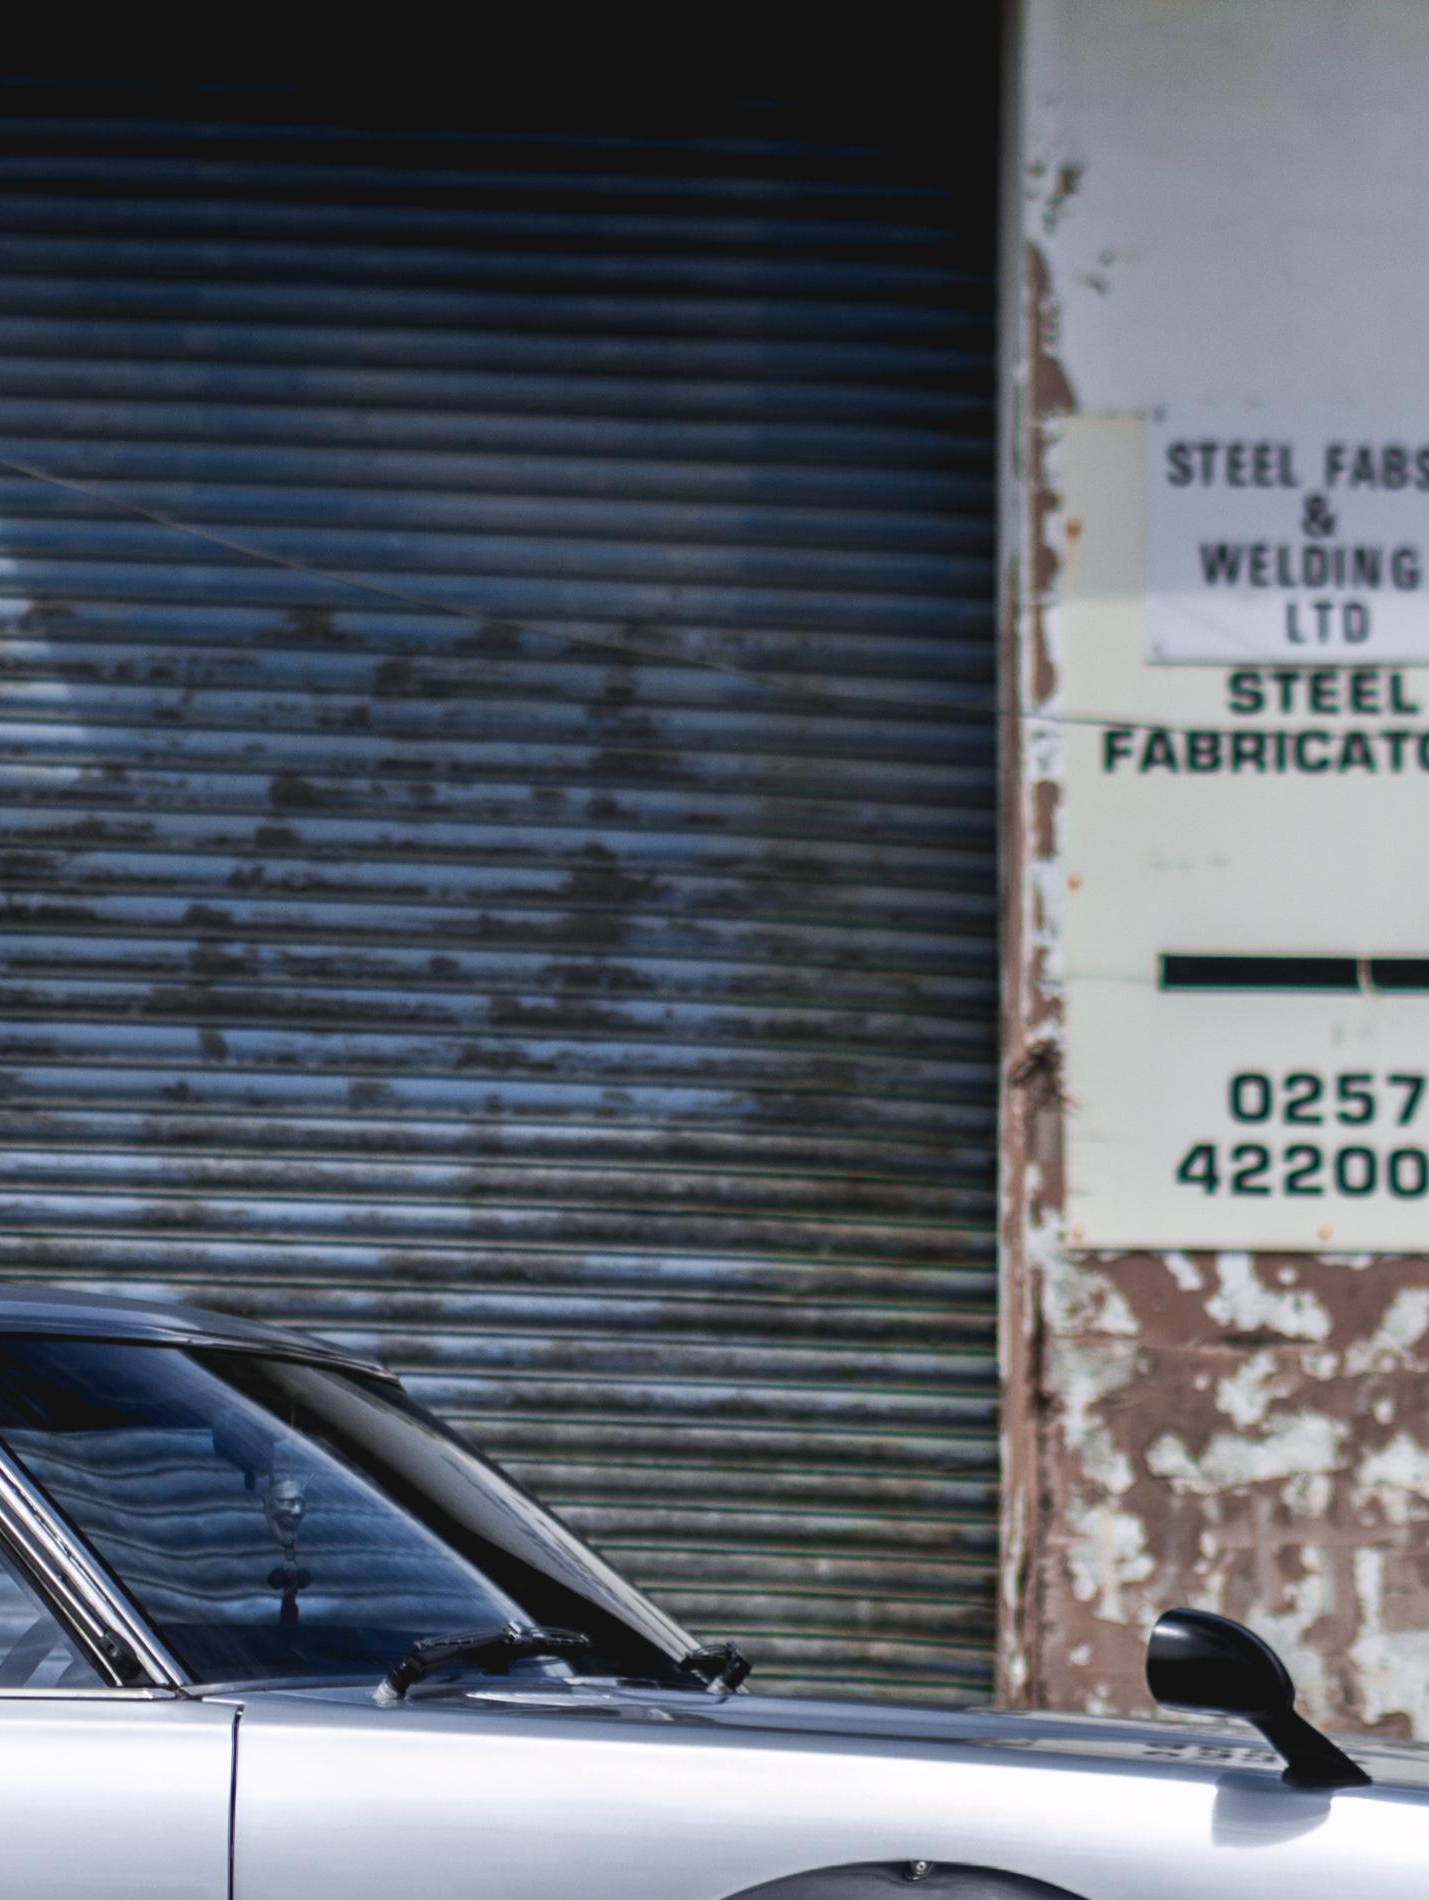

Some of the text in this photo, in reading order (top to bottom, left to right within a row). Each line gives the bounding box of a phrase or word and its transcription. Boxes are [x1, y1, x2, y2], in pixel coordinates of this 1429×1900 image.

[1166, 441, 1298, 488] STEEL
[1301, 493, 1337, 539] &
[1200, 543, 1422, 592] WELDING
[1286, 600, 1371, 645] LTD
[1227, 669, 1420, 715] STEEL
[1228, 1072, 1428, 1126] 0257
